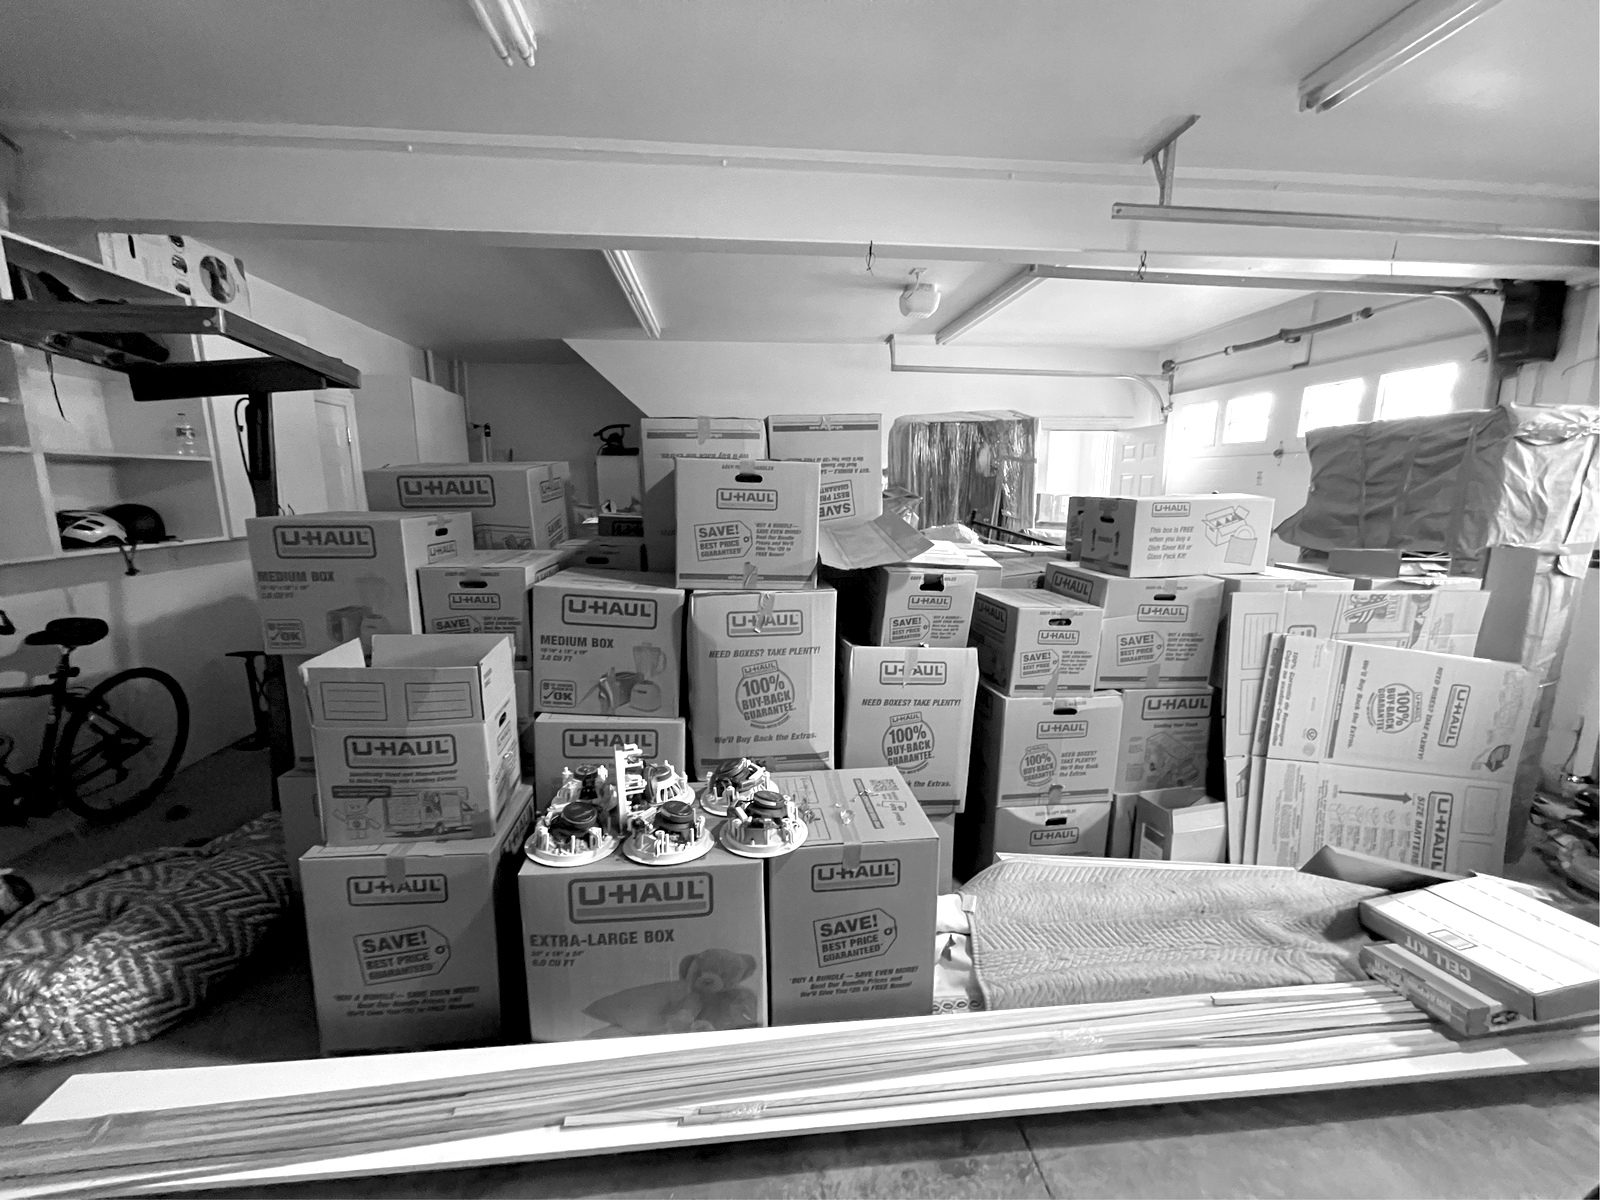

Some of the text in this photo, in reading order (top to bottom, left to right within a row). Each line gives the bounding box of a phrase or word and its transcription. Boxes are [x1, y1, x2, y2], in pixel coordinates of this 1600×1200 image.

[403, 480, 489, 495] U-HAUL
[720, 491, 774, 503] U-HAUL
[833, 491, 850, 500] BEST
[281, 530, 370, 546] U-HAUL
[699, 524, 739, 538] SAVE!
[700, 539, 739, 550] BEST PRICE
[701, 548, 741, 557] GUARANTEED
[257, 571, 335, 582] MEDIUM BOX
[1055, 575, 1089, 596] U-HAUL
[452, 596, 497, 604] U-HAUL
[911, 597, 949, 605] U-HAUL
[569, 599, 652, 618] U-HAUL
[977, 600, 1004, 623] U-HAUL
[1141, 607, 1185, 616] U-HAUL
[436, 619, 470, 630] SAVE!
[892, 617, 922, 627] SAVE!
[540, 635, 614, 649] MEDIUM BOX
[1040, 632, 1077, 640] U-HAUL
[1120, 634, 1154, 646] SAVE!
[709, 646, 821, 658] NEED BOXES? TAKE PLENTY!
[1023, 652, 1051, 663] SAVE!
[1136, 647, 1153, 655] PRICE
[744, 662, 775, 674] U-HAUL
[742, 674, 785, 697] 100%
[742, 690, 791, 711] BUY-BACK
[862, 698, 881, 706] NEED
[932, 699, 961, 707] PLENTY!
[1147, 698, 1209, 710] U-HAUL
[1386, 688, 1396, 730] BUY-BACK
[1396, 691, 1410, 726] 100%
[892, 714, 919, 723] U-HAUL
[1446, 690, 1467, 743] U-HAUL
[889, 724, 926, 744] 100%
[1040, 724, 1085, 733] U-HAUL
[569, 733, 652, 747] U-HAUL
[714, 736, 734, 744] We'll
[736, 736, 751, 744] Buy
[791, 732, 817, 740] Extras.
[351, 741, 449, 756] U-HAUL
[887, 740, 931, 756] BUY-BACK
[1417, 732, 1429, 760] PLENTY!
[1025, 752, 1052, 767] 100%
[1023, 763, 1054, 775] BUY-BACK
[1415, 796, 1426, 817] SIZE
[1034, 830, 1076, 840] U-HAUL
[1431, 798, 1450, 870] U-HAUL
[818, 864, 896, 880] U-HAUL
[354, 879, 441, 895] U-HAUL
[579, 881, 705, 905] U-HAUL
[820, 914, 878, 938] SAVE!
[362, 930, 427, 954] SAVE!
[530, 929, 675, 948] EXTRA-LARGE BOX
[822, 934, 879, 953] BEST PRICE
[823, 944, 884, 962] GUARANTEED
[1405, 936, 1429, 958] KIT
[365, 952, 430, 970] BEST PRICE
[1432, 950, 1472, 982] CELL
[855, 971, 873, 979] SAVE
[875, 969, 894, 977] EVEN
